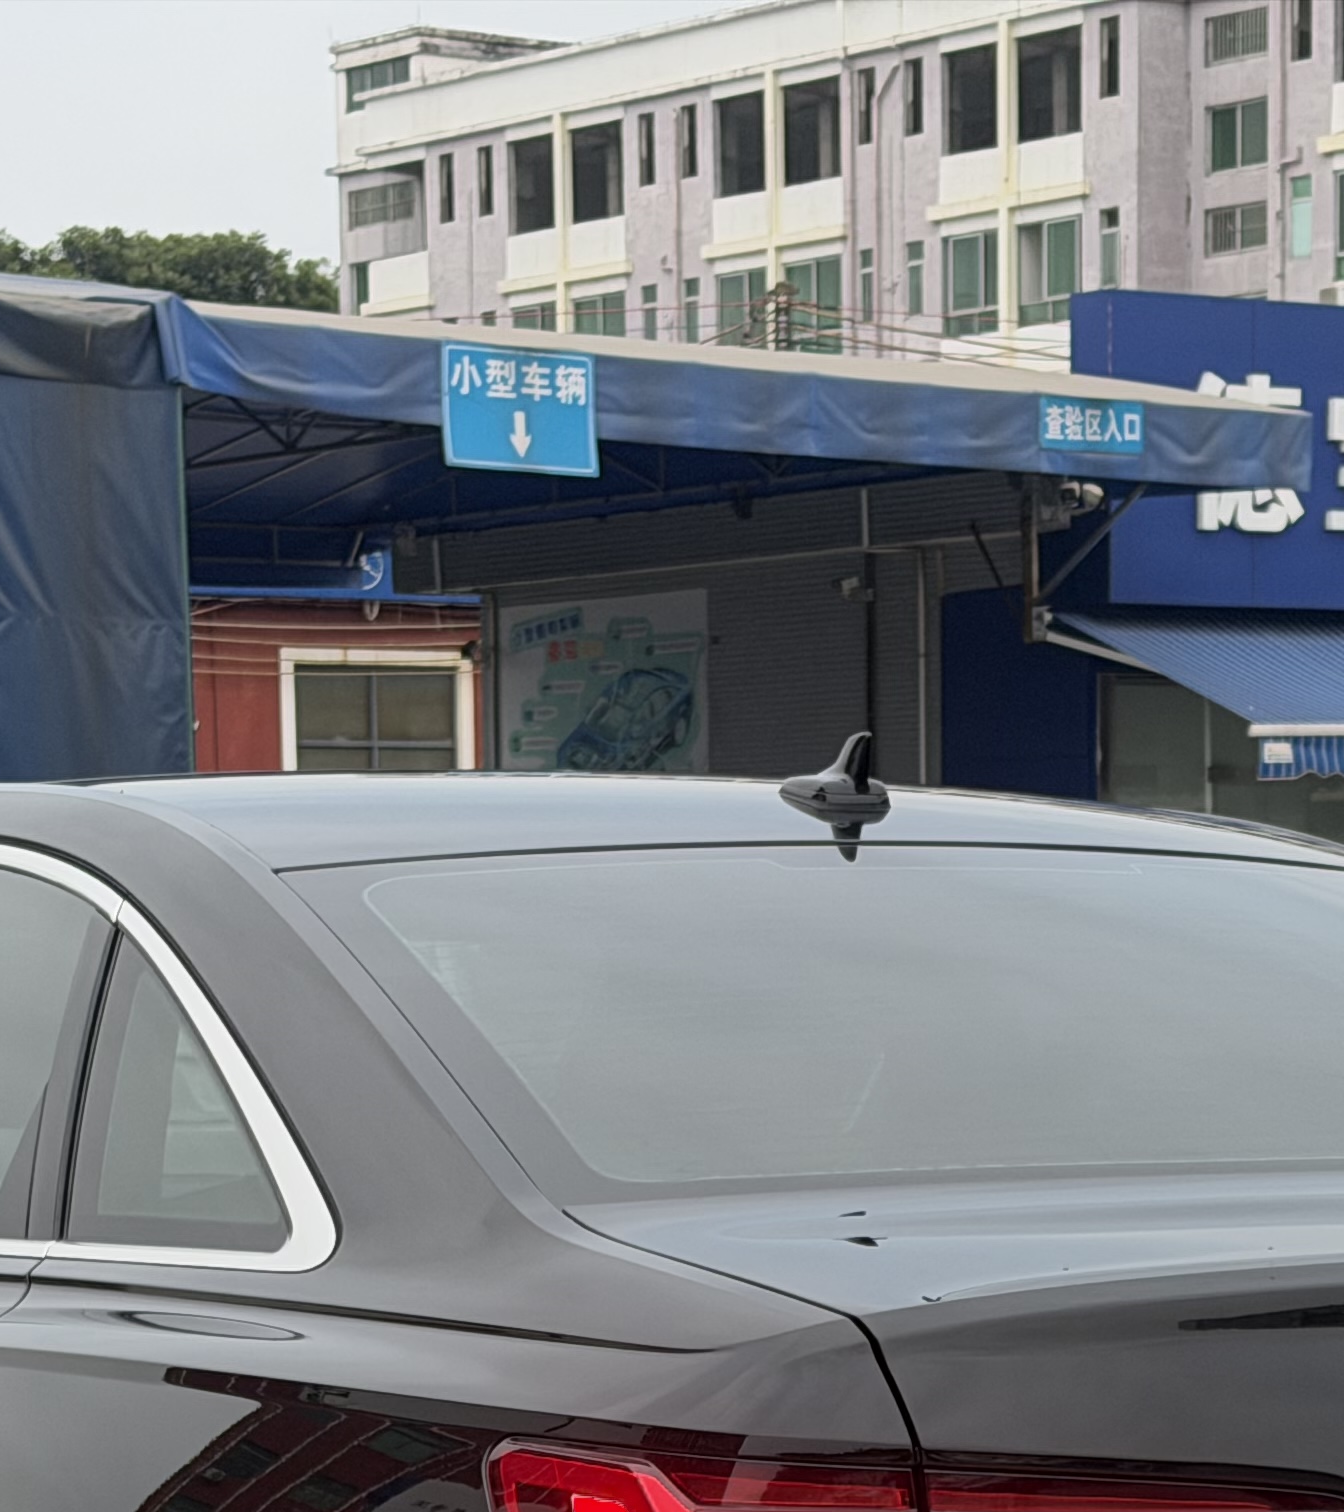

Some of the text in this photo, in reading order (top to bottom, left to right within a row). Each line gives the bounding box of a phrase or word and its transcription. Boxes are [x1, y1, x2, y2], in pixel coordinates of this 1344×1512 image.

[451, 355, 586, 406] 小型车辆
[1045, 405, 1141, 442] 查验区入口
